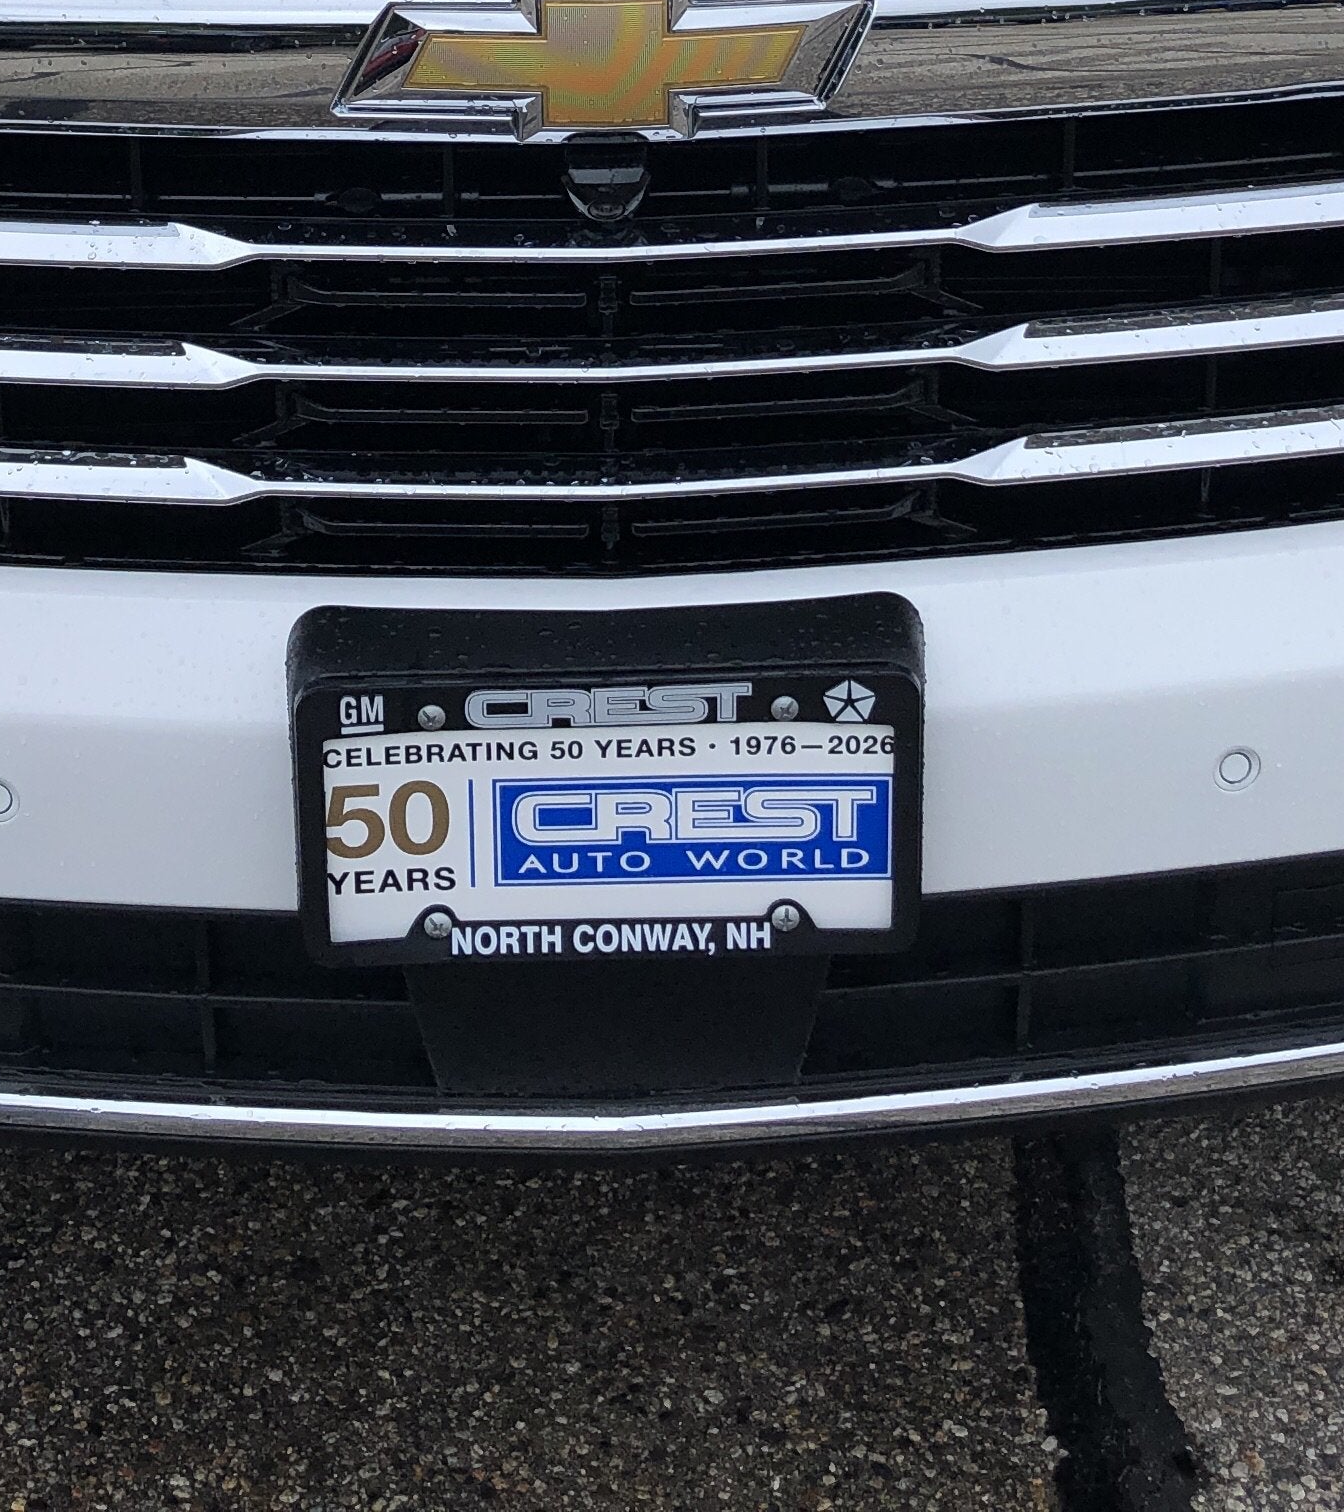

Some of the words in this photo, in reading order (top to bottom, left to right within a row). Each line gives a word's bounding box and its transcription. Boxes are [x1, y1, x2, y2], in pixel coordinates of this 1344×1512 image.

[340, 695, 384, 725] GM
[465, 682, 753, 729] CREST
[323, 741, 538, 769] CELEBRATING
[550, 740, 583, 760] 50
[593, 737, 696, 759] YEARS
[326, 779, 450, 859] 50
[512, 786, 876, 845] CREST
[518, 851, 651, 874] AUTO
[686, 848, 870, 871] WORLD
[327, 866, 457, 895] YEARS
[451, 925, 562, 956] NORTH
[572, 922, 715, 955] CONWAY,
[726, 922, 771, 950] NH
